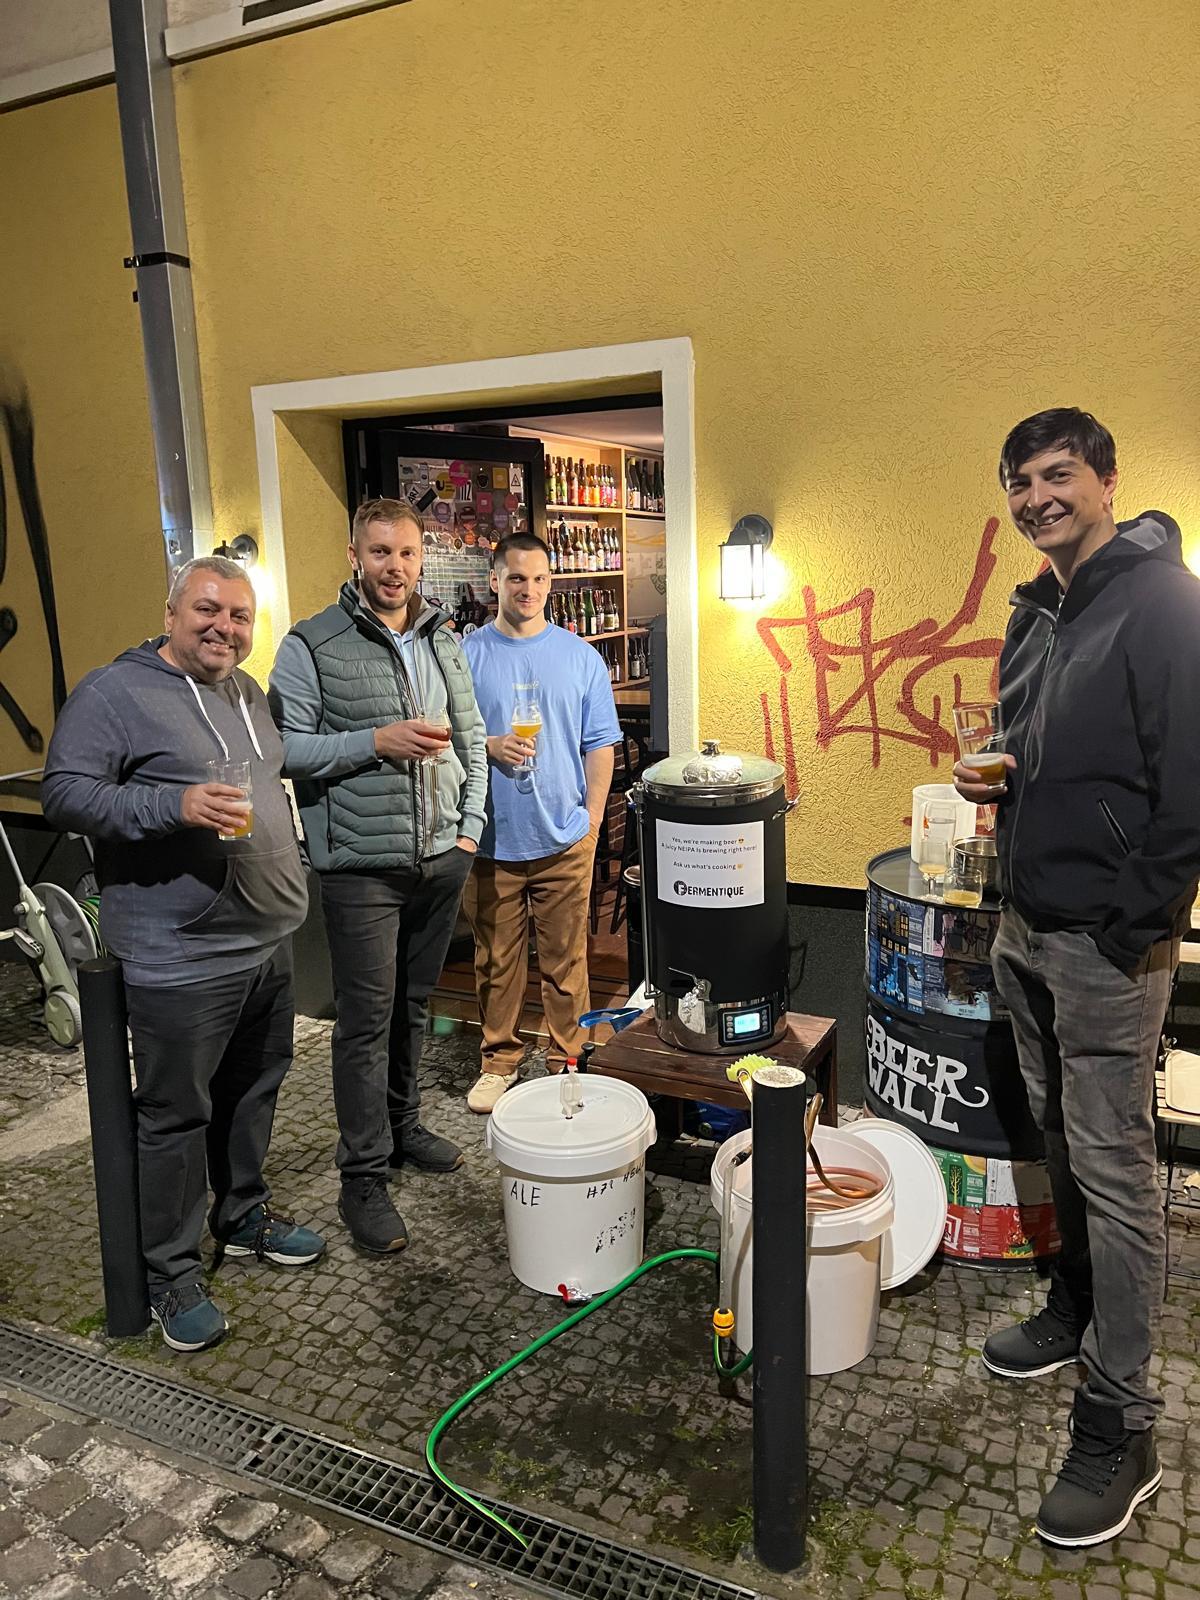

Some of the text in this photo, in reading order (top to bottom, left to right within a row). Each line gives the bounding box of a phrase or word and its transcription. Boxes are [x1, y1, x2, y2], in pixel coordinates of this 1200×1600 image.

[665, 843, 677, 851] juicy
[702, 846, 727, 854] brewing
[728, 846, 742, 854] right
[712, 863, 737, 871] cooking
[673, 880, 744, 898] FERMENTIQUE
[866, 1015, 990, 1108] BEER
[868, 1053, 959, 1133] WALL
[510, 1180, 542, 1207] ALE
